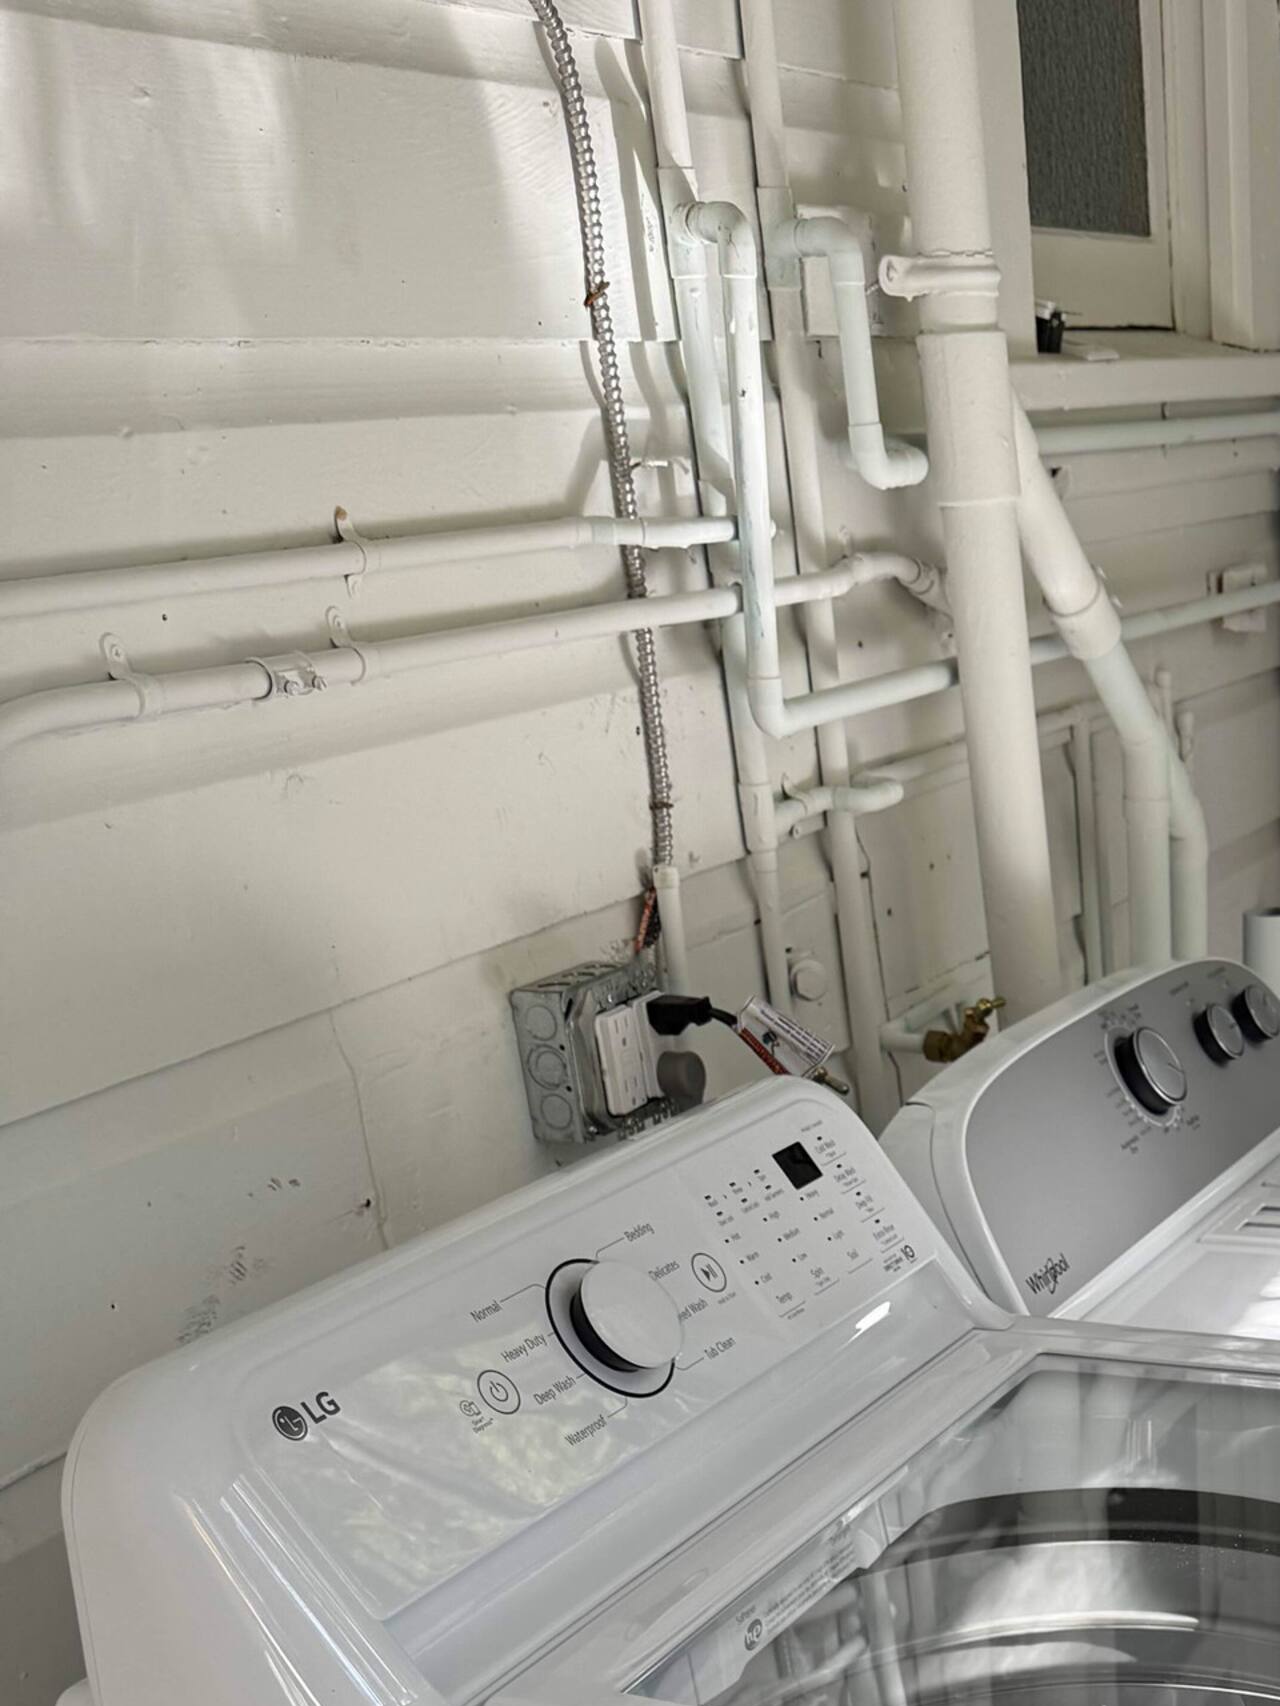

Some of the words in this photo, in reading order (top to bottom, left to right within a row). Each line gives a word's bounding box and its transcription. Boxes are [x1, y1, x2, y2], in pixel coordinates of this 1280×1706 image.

[624, 1221, 655, 1243] Bedding
[648, 1260, 680, 1281] Delicates
[1025, 1252, 1070, 1295] Whirlpool
[470, 1300, 502, 1323] Normal
[500, 1341, 529, 1363] Heavy
[525, 1333, 548, 1354] Duty
[533, 1386, 556, 1406] Deep
[552, 1376, 576, 1395] Wash
[300, 1391, 341, 1425] LG
[564, 1414, 608, 1447] Waterproof
